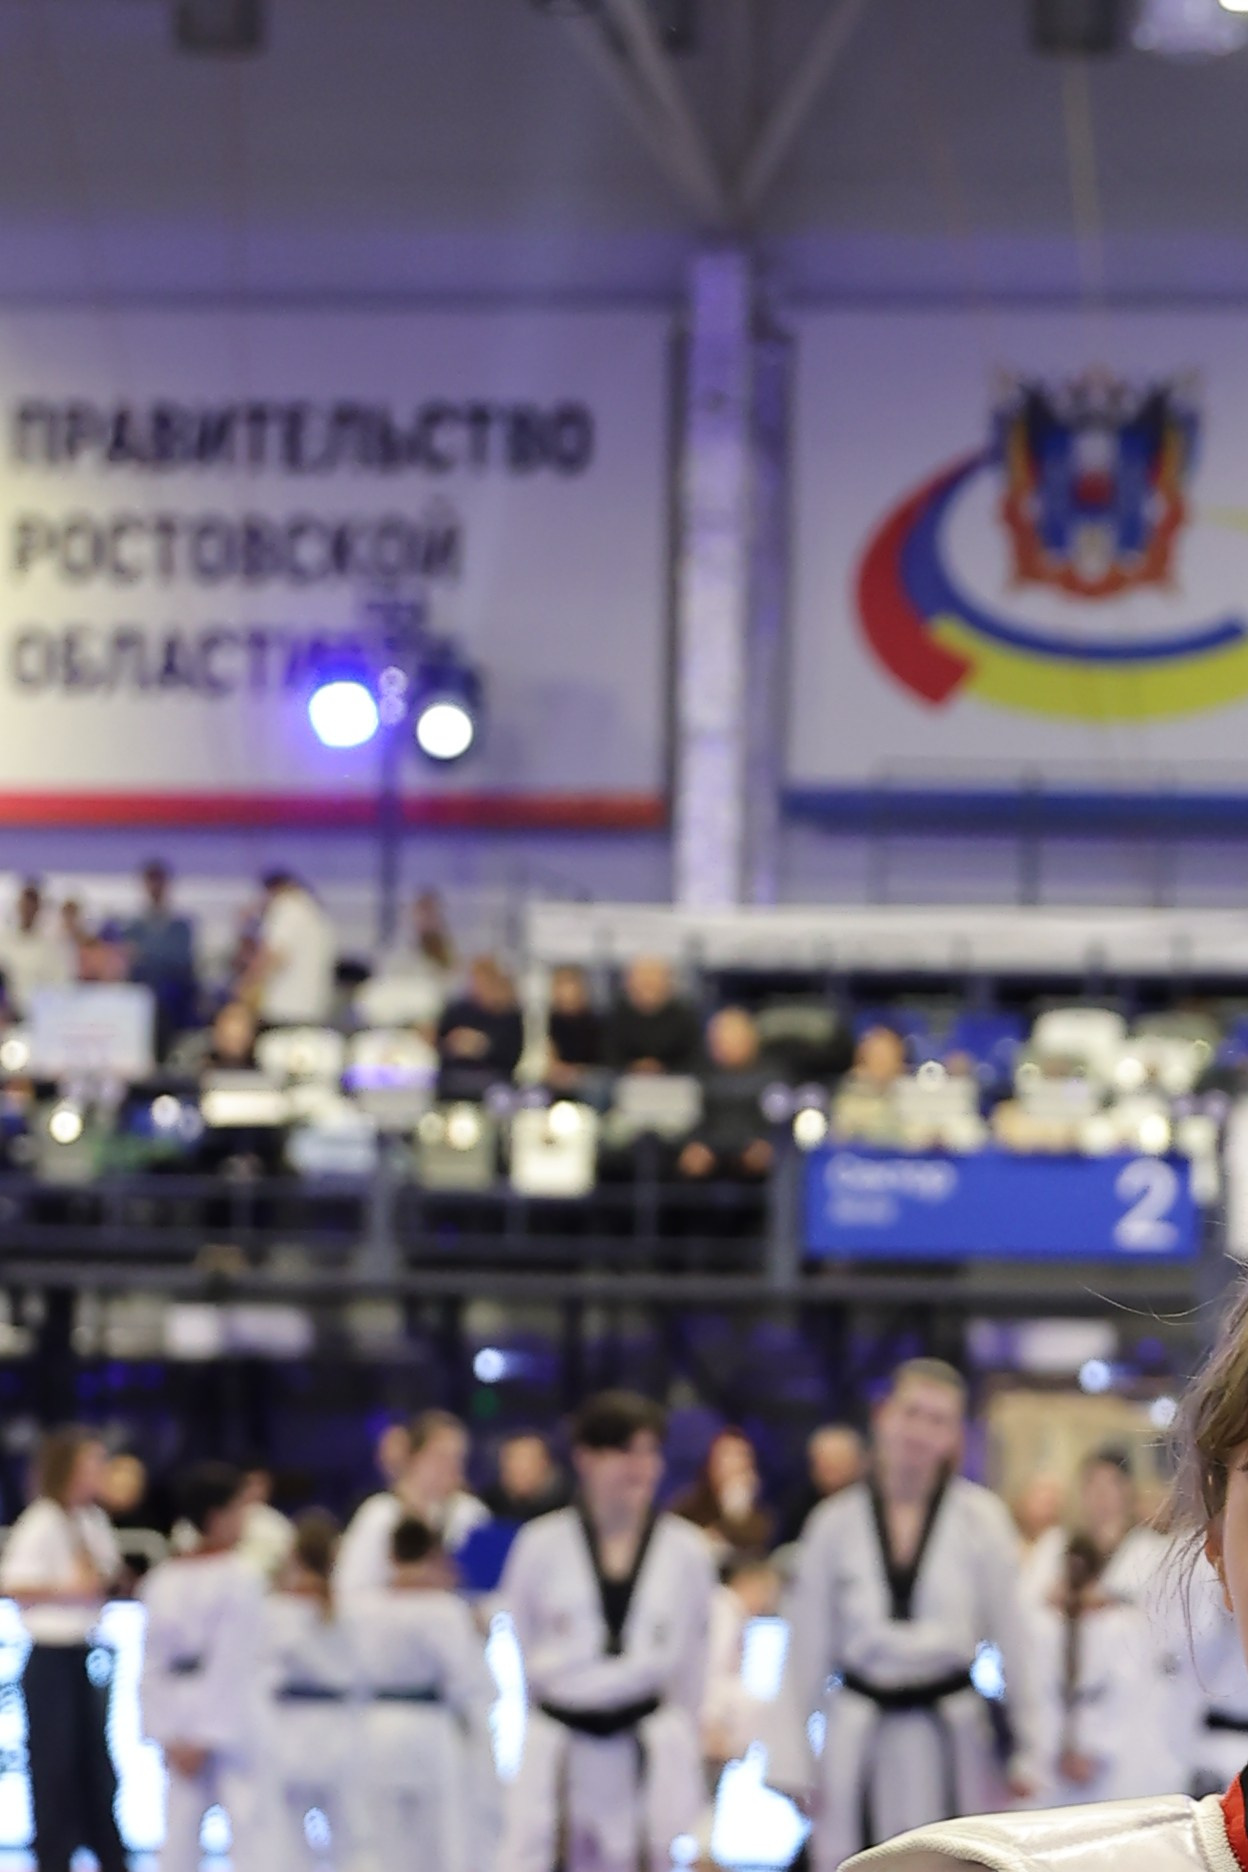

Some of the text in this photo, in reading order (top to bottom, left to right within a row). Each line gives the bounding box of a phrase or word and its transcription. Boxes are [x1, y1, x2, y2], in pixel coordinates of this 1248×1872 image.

[12, 400, 594, 474] ПРАВИТЕЛЬСТВО
[12, 502, 464, 582] РОСТОВСКОЙ
[1112, 1157, 1178, 1252] 2
